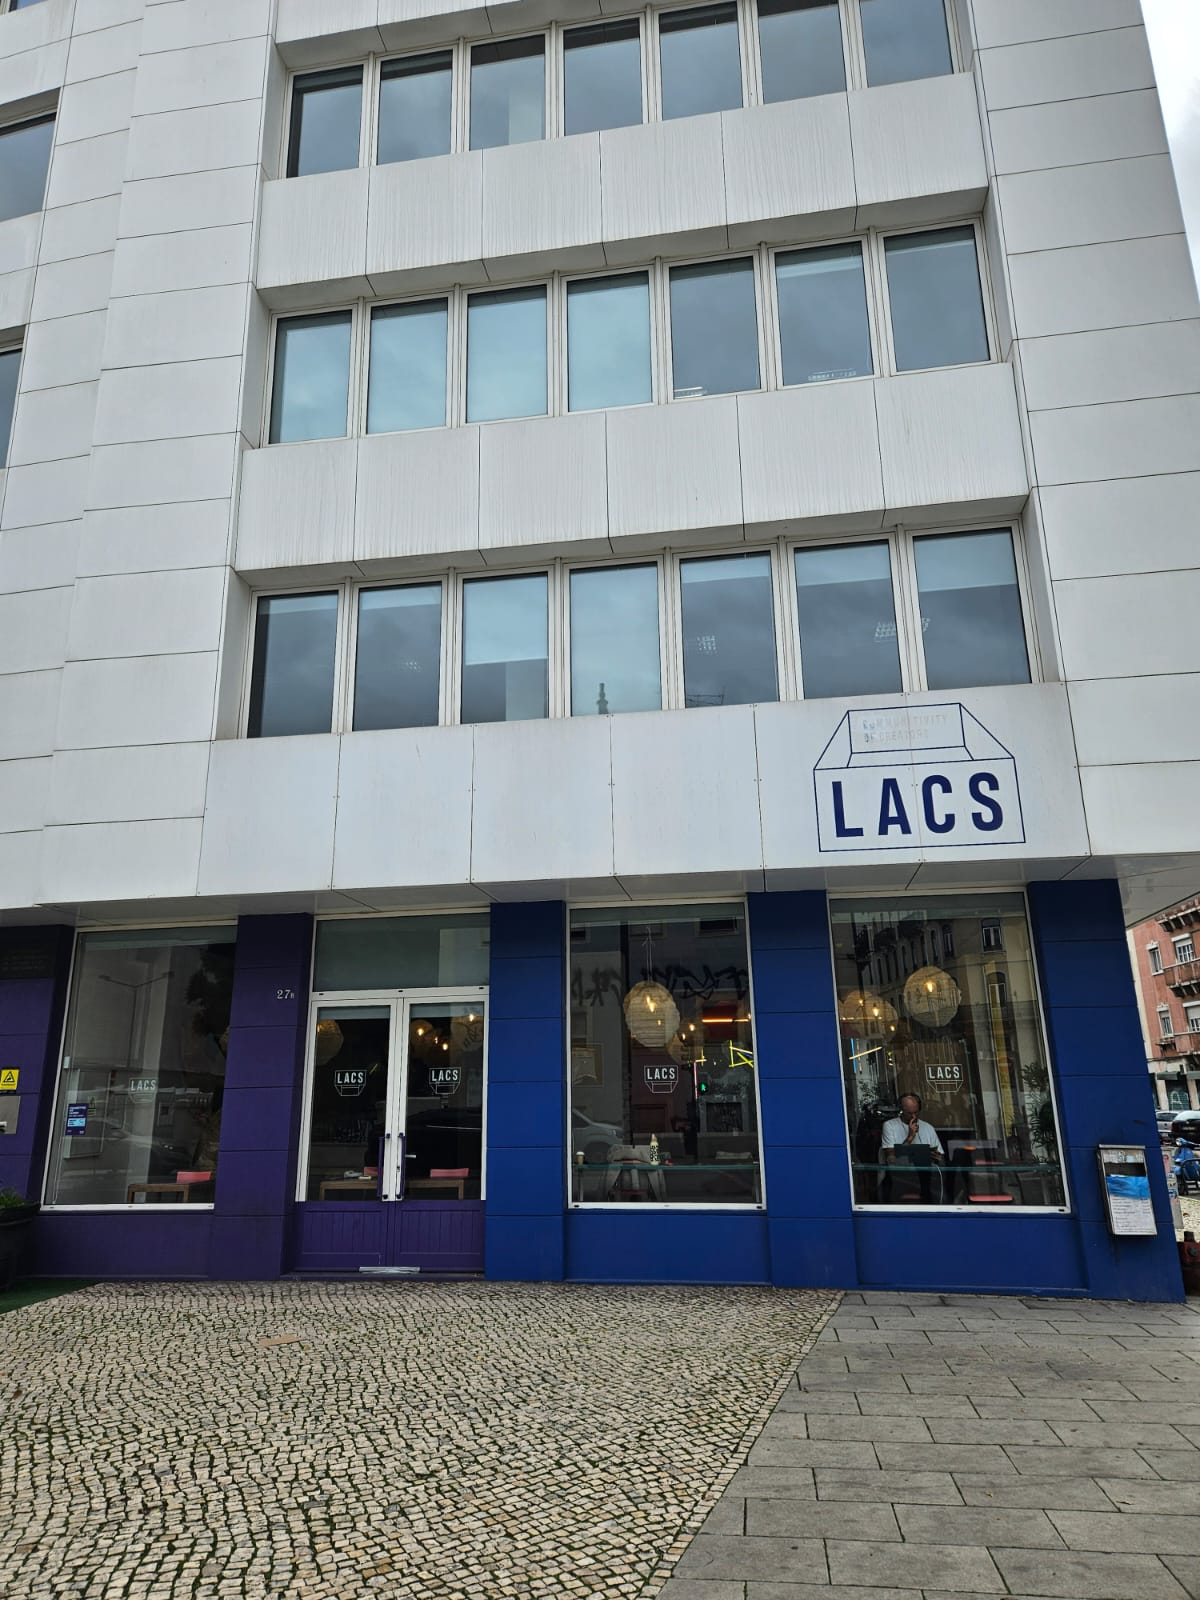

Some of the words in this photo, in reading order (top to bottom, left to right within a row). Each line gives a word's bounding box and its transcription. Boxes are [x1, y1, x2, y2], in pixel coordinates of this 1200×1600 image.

[832, 772, 1004, 838] LACS
[337, 1072, 364, 1084] LACS
[432, 1069, 459, 1082] LACS
[646, 1067, 676, 1080] LACS
[928, 1066, 960, 1079] LACS
[130, 1079, 157, 1092] LACS
